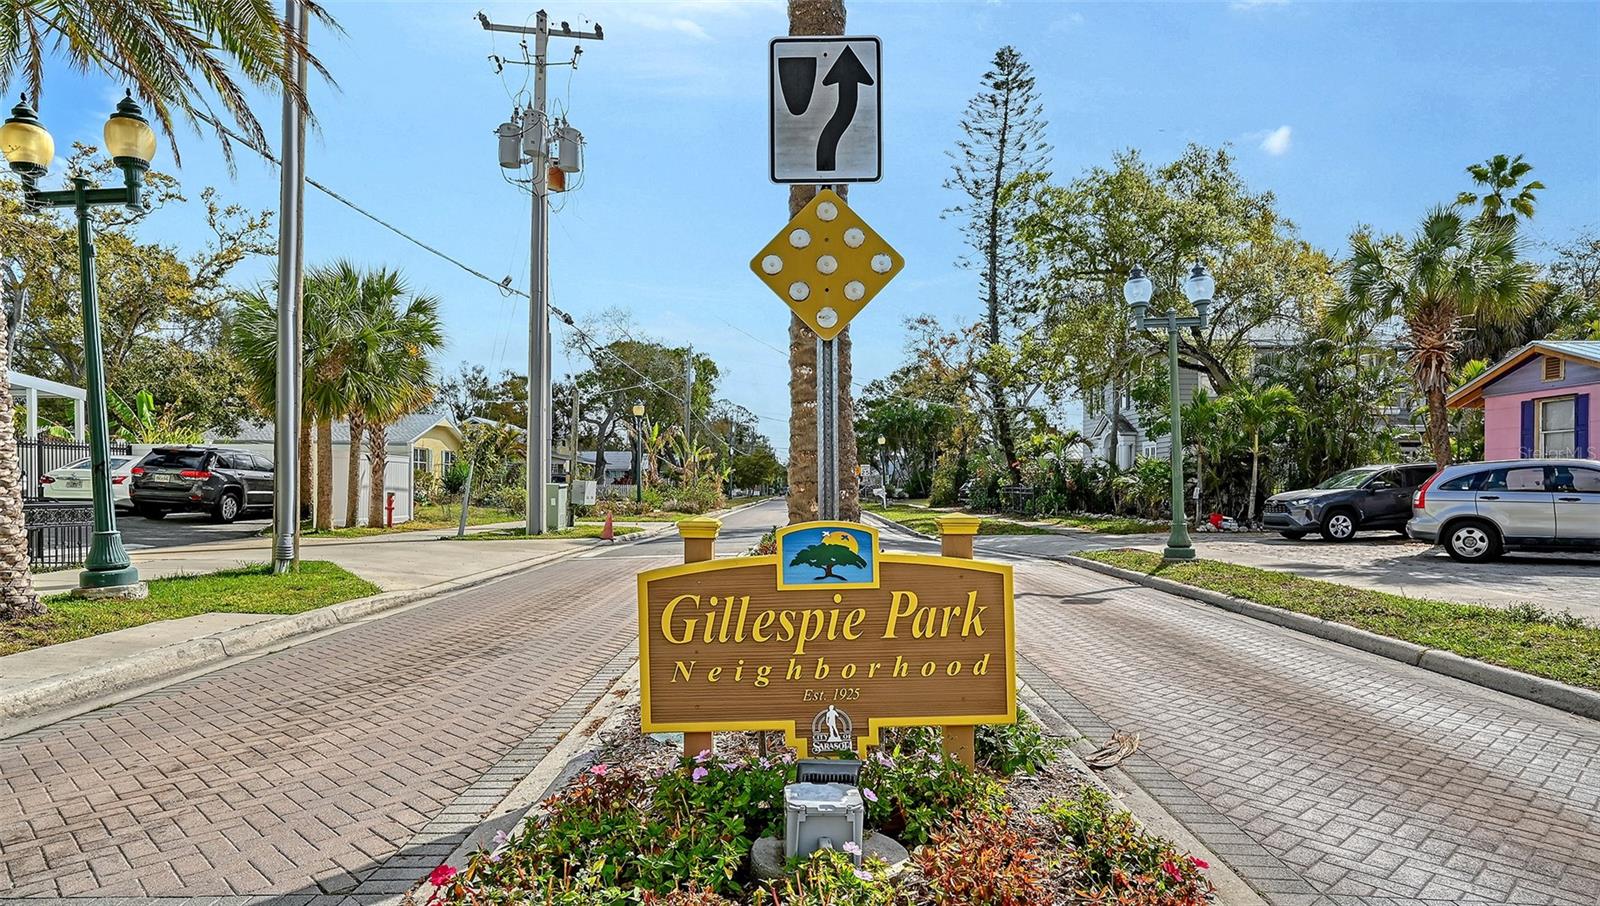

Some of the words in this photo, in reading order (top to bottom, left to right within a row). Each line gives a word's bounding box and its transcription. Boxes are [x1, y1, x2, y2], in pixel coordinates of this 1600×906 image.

[661, 593, 866, 656] Gillespie
[881, 589, 988, 639] Park
[670, 652, 990, 688] Neighborhood
[803, 689, 827, 702] Est.
[833, 688, 860, 701] 1925
